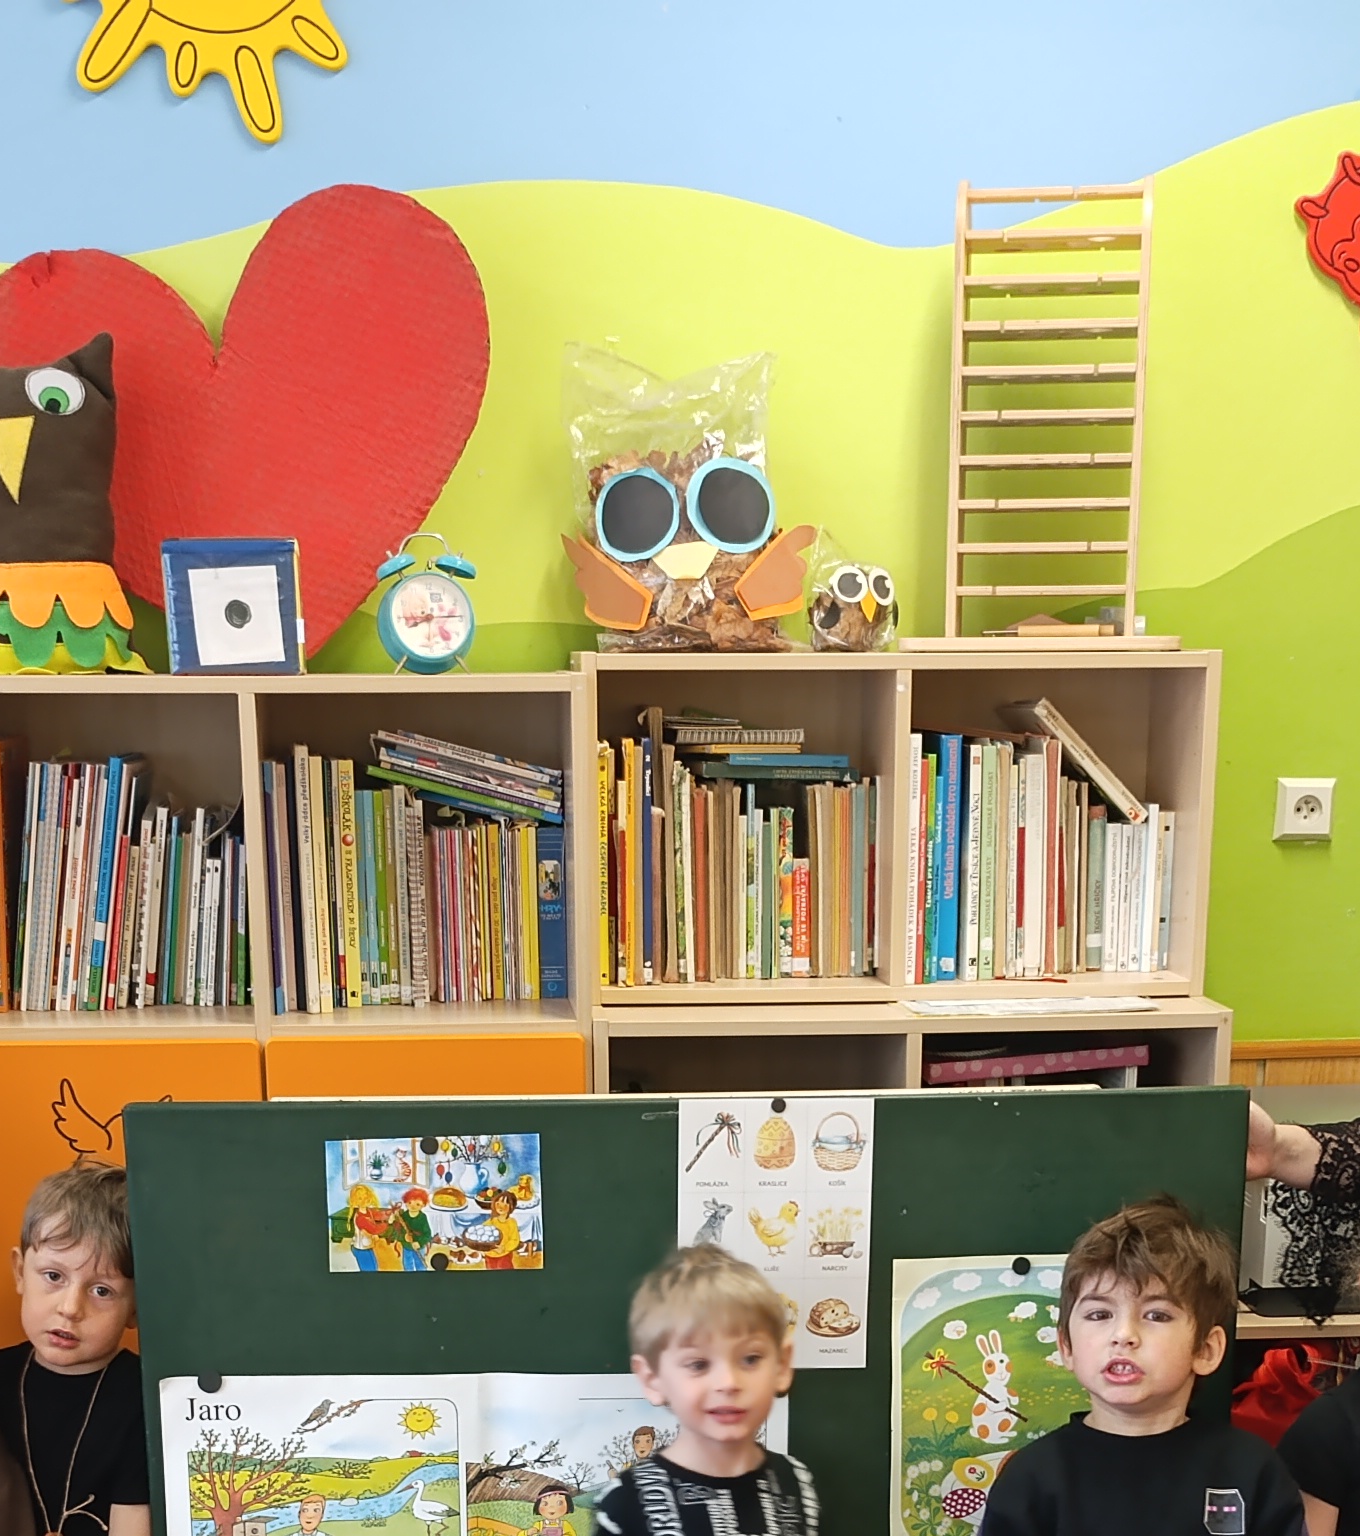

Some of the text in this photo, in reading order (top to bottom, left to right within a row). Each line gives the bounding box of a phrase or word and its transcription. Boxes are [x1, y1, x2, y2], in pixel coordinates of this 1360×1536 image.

[695, 1179, 729, 1188] POMLÁZKA
[828, 1179, 847, 1187] KOŠÍK
[763, 1264, 780, 1272] KUŘE
[821, 1264, 848, 1272] NARCISY
[185, 1397, 242, 1423] Jaro
